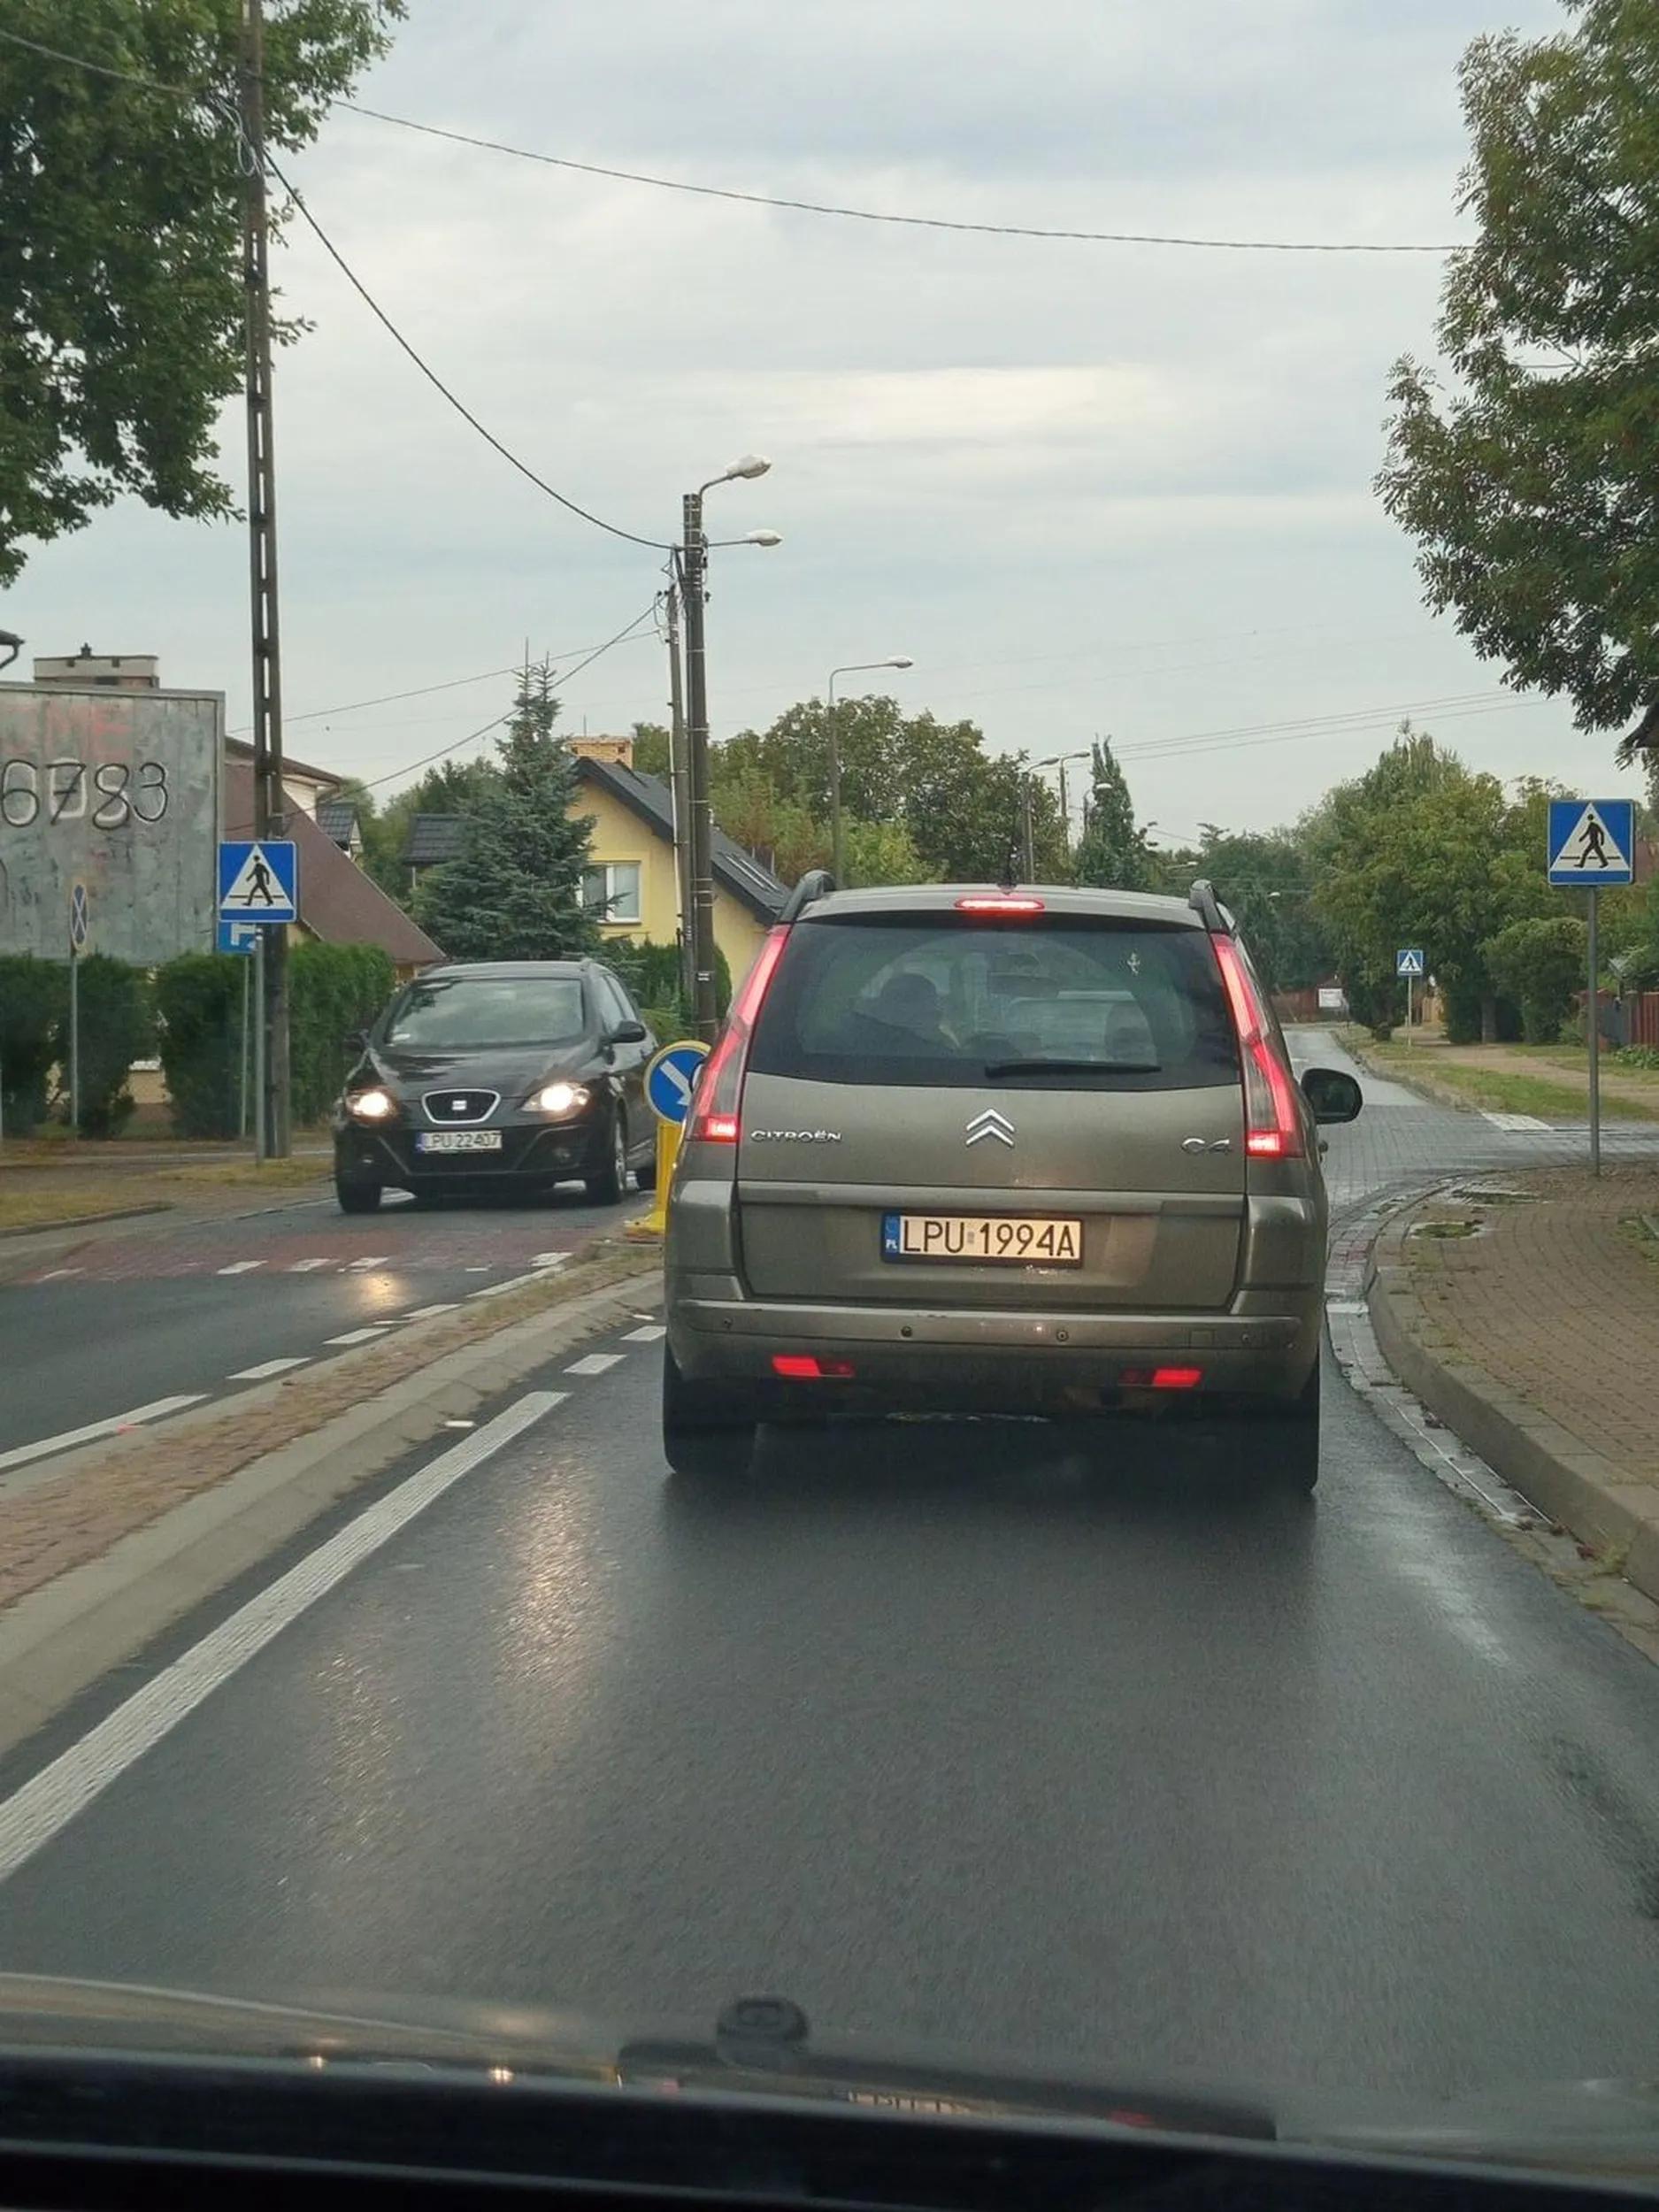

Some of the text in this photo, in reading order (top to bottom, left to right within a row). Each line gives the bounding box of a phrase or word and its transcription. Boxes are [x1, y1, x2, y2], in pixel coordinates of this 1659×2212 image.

[1, 758, 169, 830] 6783
[1181, 1138, 1231, 1156] C4
[903, 1220, 1074, 1256] LPU 1994A
